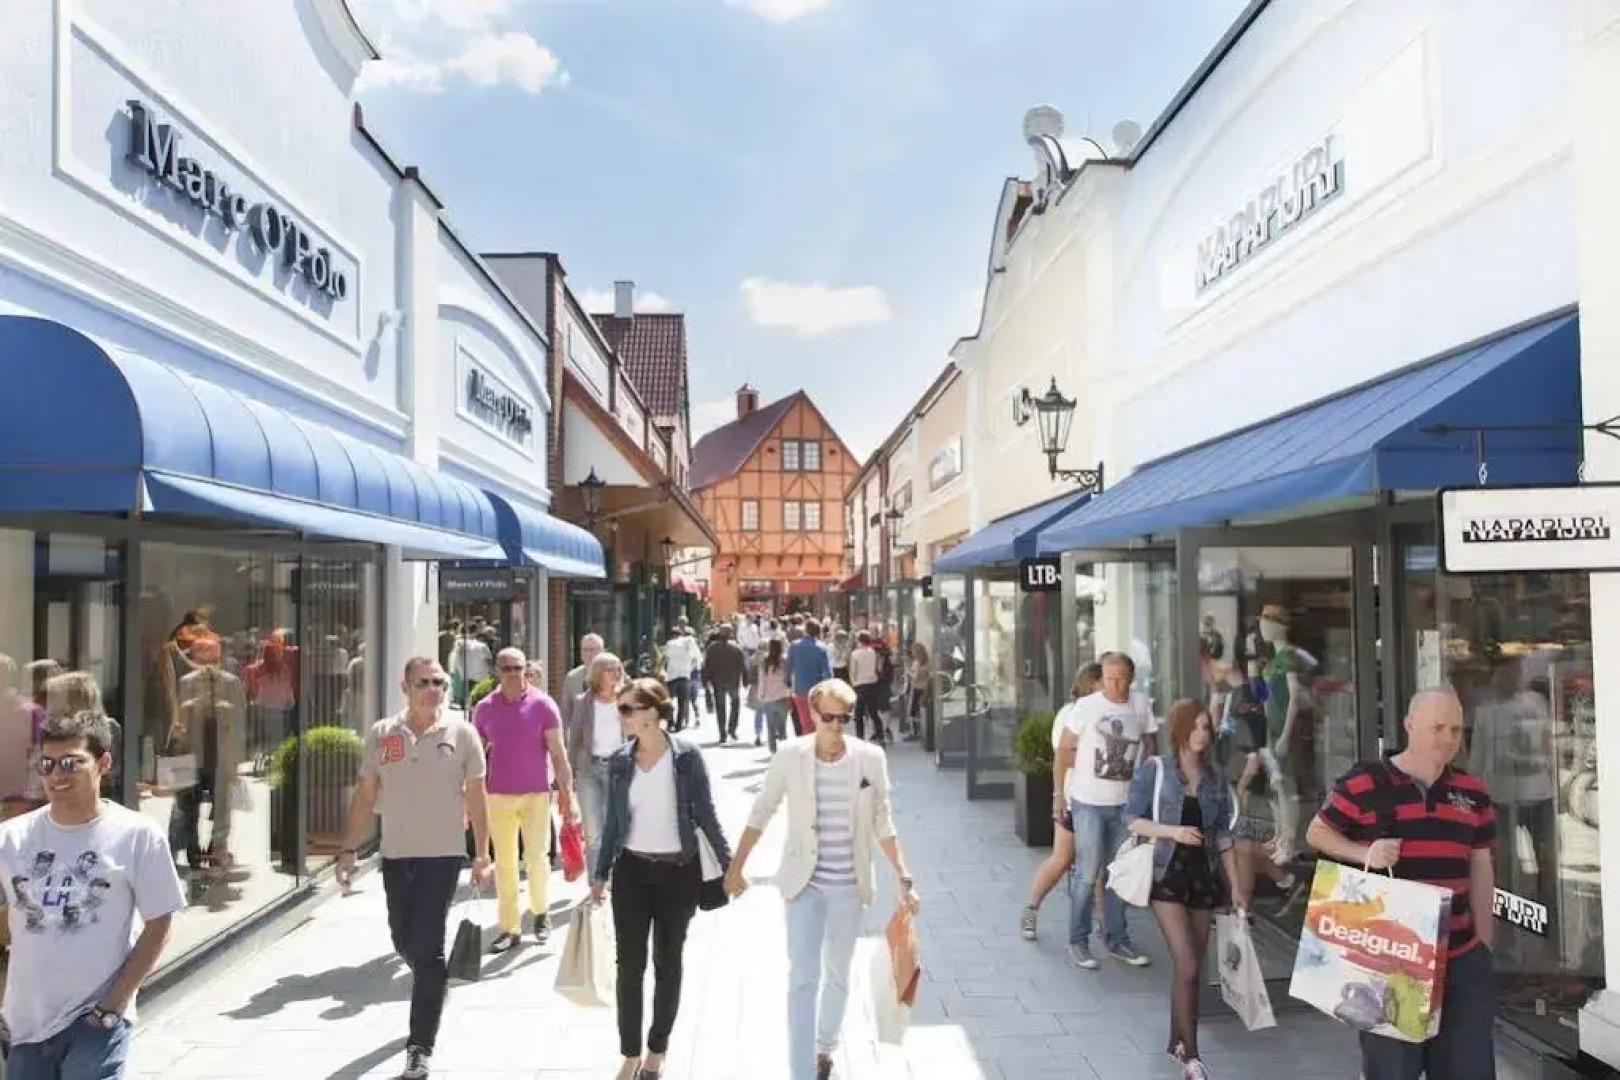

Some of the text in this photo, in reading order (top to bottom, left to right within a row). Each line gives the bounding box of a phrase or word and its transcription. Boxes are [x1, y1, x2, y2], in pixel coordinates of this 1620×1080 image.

[1197, 134, 1339, 286] NAPAPIJRI
[246, 203, 346, 301] O'Polo
[1468, 515, 1605, 541] NAPAPIJRI
[1027, 564, 1057, 585] LTB
